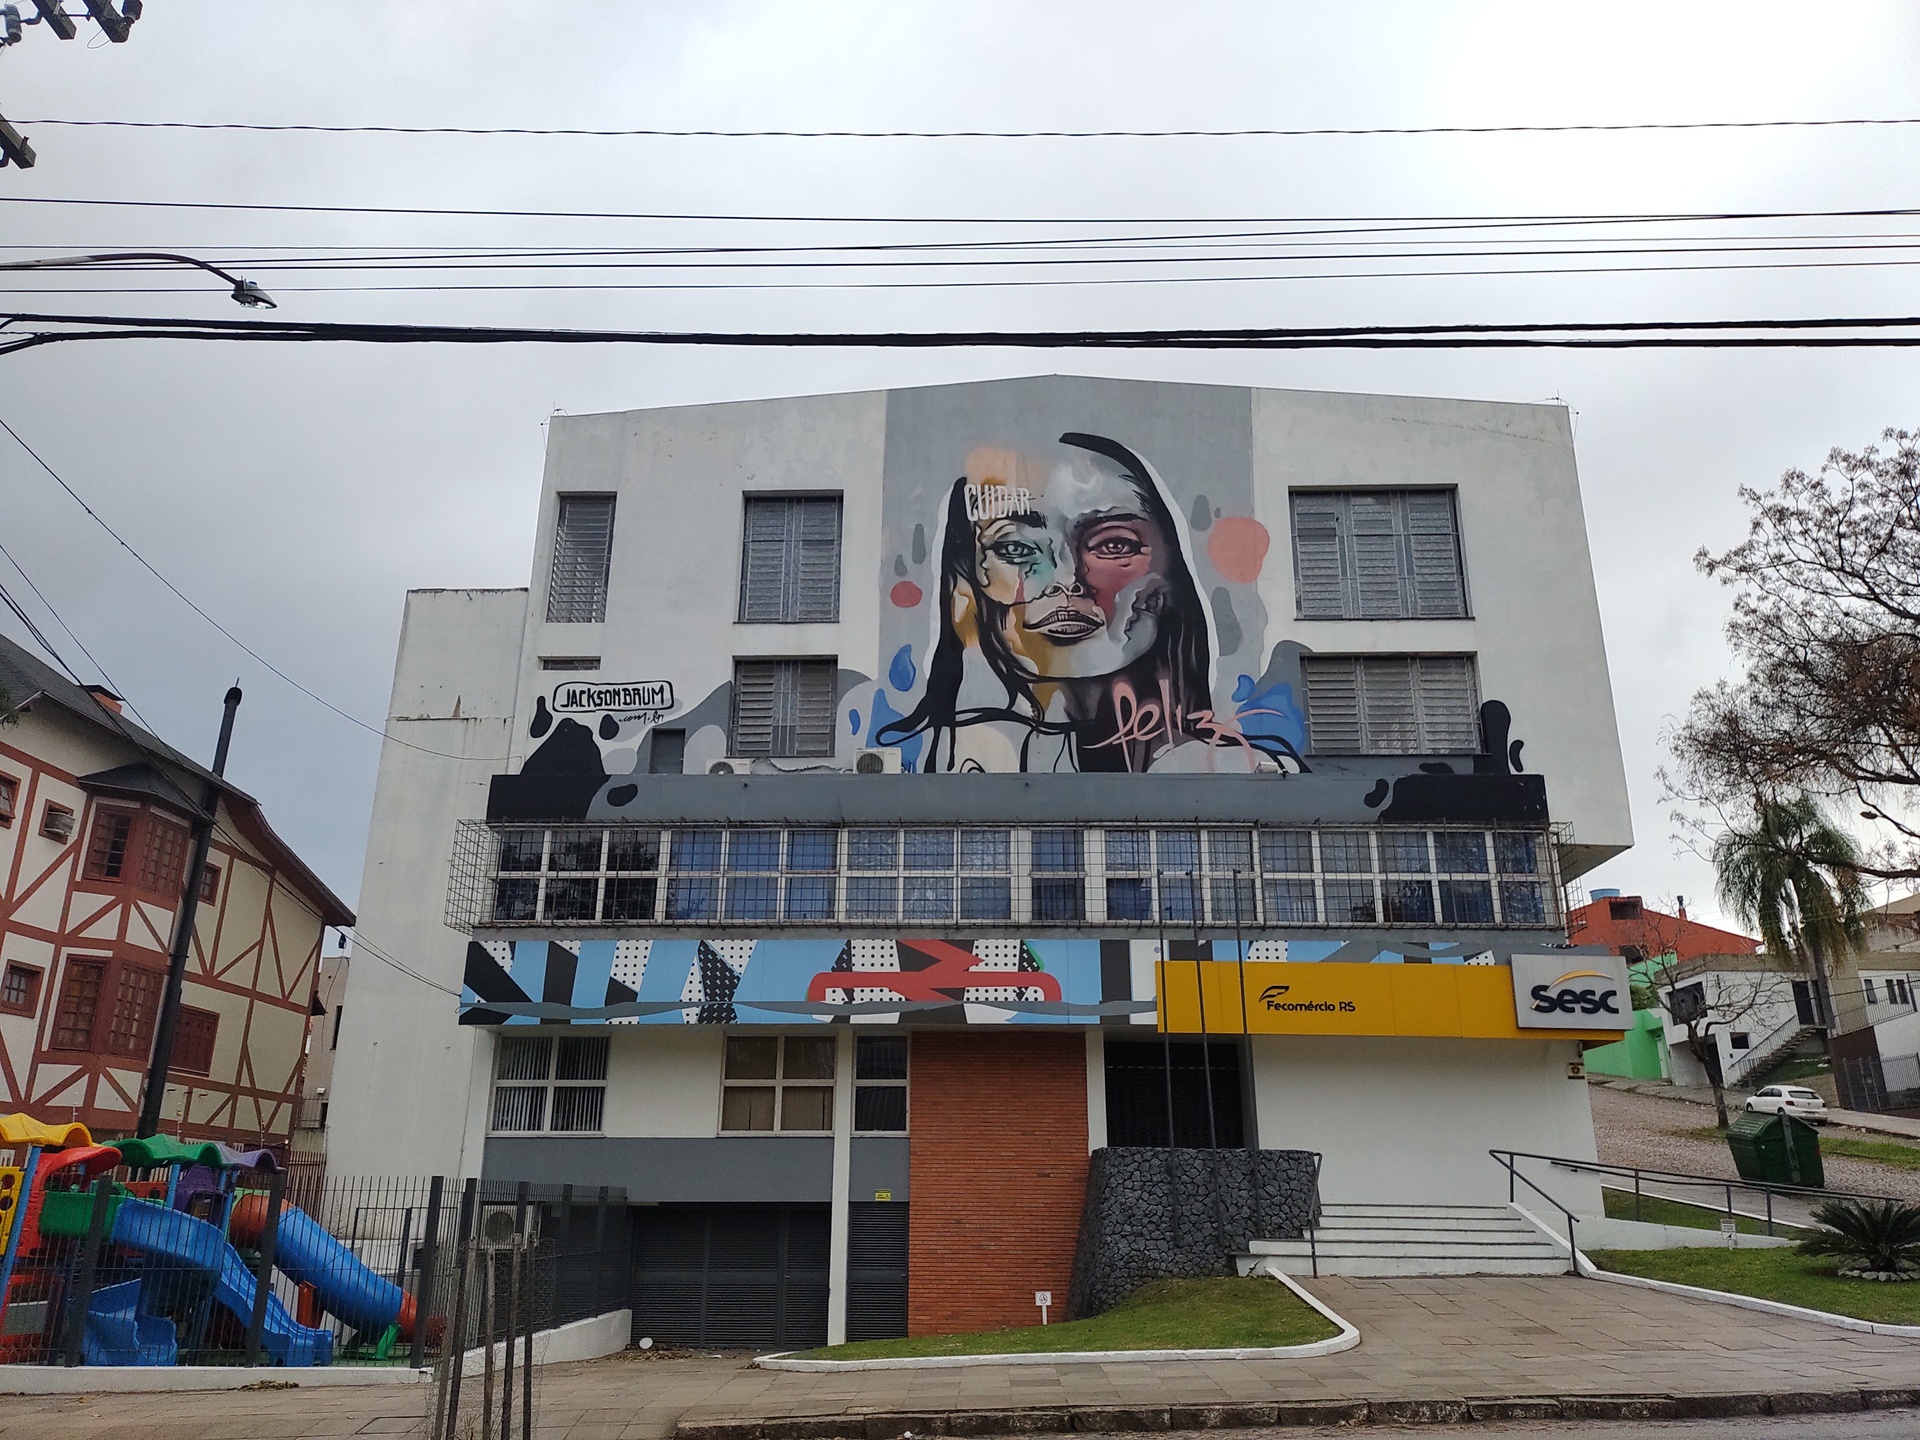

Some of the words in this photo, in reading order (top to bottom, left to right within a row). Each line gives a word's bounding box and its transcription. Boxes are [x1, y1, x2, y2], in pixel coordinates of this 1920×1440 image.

[963, 483, 1031, 522] CUIDAR
[1266, 1000, 1336, 1012] Fecomércio
[1339, 1001, 1356, 1012] RS
